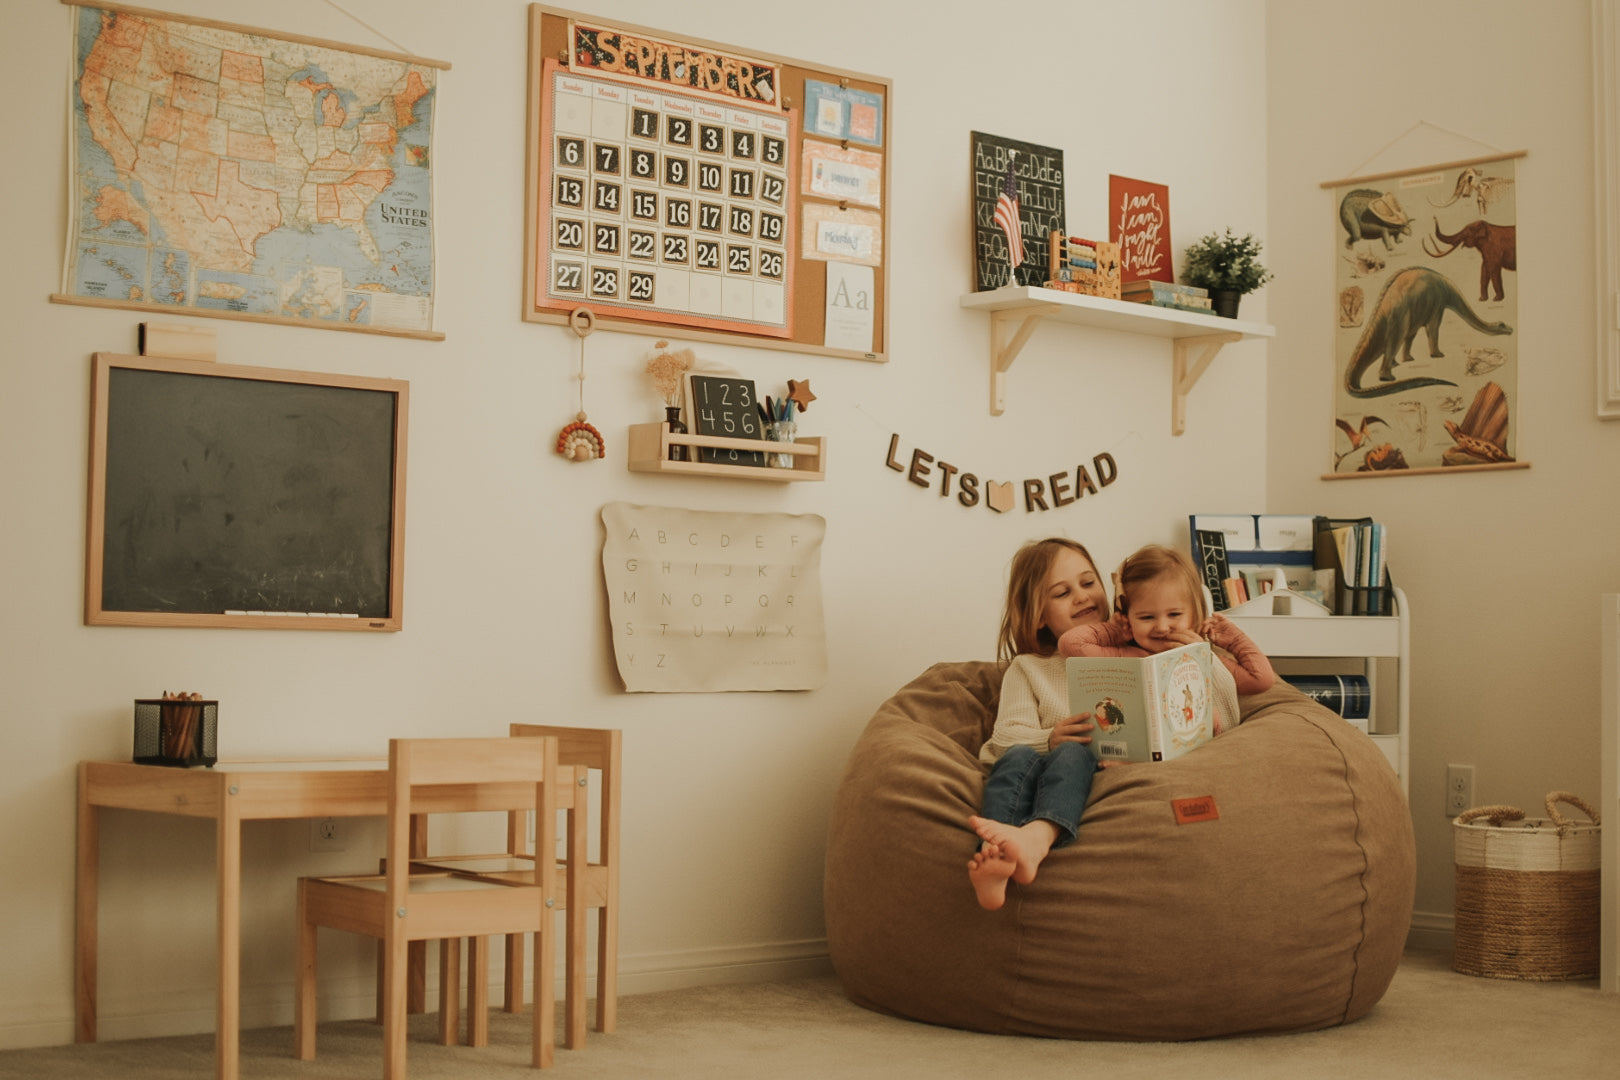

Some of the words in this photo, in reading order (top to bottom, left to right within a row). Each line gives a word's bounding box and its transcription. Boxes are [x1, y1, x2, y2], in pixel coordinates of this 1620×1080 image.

[597, 31, 757, 98] SEPTEMBER
[563, 81, 583, 93] Sunday
[598, 87, 620, 99] Monday
[633, 94, 654, 106] Tuesday
[664, 100, 692, 113] Wednesday
[699, 107, 722, 119] Thursday
[733, 114, 749, 124] Friday
[641, 114, 649, 135] 1
[673, 121, 686, 142] 2
[705, 128, 718, 150] 3
[737, 135, 749, 155] 4
[767, 141, 778, 162] 5
[565, 142, 578, 163] 6
[601, 148, 613, 169] 7
[636, 154, 649, 175] 8
[671, 161, 683, 182] 9
[701, 166, 720, 188] 10
[733, 173, 750, 195] 11
[763, 178, 782, 201] 12
[381, 203, 428, 218] UNITED
[381, 213, 427, 227] STATES
[561, 181, 580, 203] 13
[598, 186, 617, 208] 14
[635, 195, 655, 217] 15
[669, 202, 689, 224] 16
[701, 206, 720, 228] 17
[731, 210, 751, 233] 18
[761, 216, 781, 238] 19
[558, 223, 582, 246] 20
[597, 228, 616, 250] 21
[630, 234, 654, 257] 22
[664, 237, 687, 260] 23
[697, 244, 718, 266] 24
[729, 249, 750, 271] 25
[760, 253, 782, 275] 26
[557, 265, 581, 288] 27
[593, 271, 616, 293] 28
[630, 275, 653, 298] 29
[830, 277, 869, 310] Aa
[703, 381, 709, 405] 1
[719, 383, 733, 406] 2
[739, 385, 751, 407] 3
[701, 408, 716, 430] 4
[723, 411, 735, 433] 5
[741, 413, 754, 434] 6
[885, 433, 980, 508] LETS
[1023, 452, 1118, 513] READ
[628, 527, 640, 541] A
[657, 530, 667, 544] B
[688, 532, 698, 546] C
[720, 534, 730, 548] D
[755, 535, 765, 548] E
[790, 535, 798, 548] F
[626, 558, 638, 572] G
[662, 561, 670, 574] H
[694, 563, 698, 576] I
[724, 564, 732, 577] J
[758, 565, 768, 577] K
[791, 565, 797, 578] L
[624, 591, 636, 604] M
[661, 592, 671, 606] N
[692, 593, 702, 607] O
[724, 594, 733, 606] P
[758, 594, 769, 607] Q
[786, 595, 794, 607] R
[626, 622, 633, 636] S
[660, 623, 669, 636] T
[694, 624, 704, 637] U
[726, 625, 735, 638] V
[756, 625, 767, 637] W
[785, 625, 794, 638] X
[626, 654, 634, 666] Y
[656, 654, 666, 668] Z
